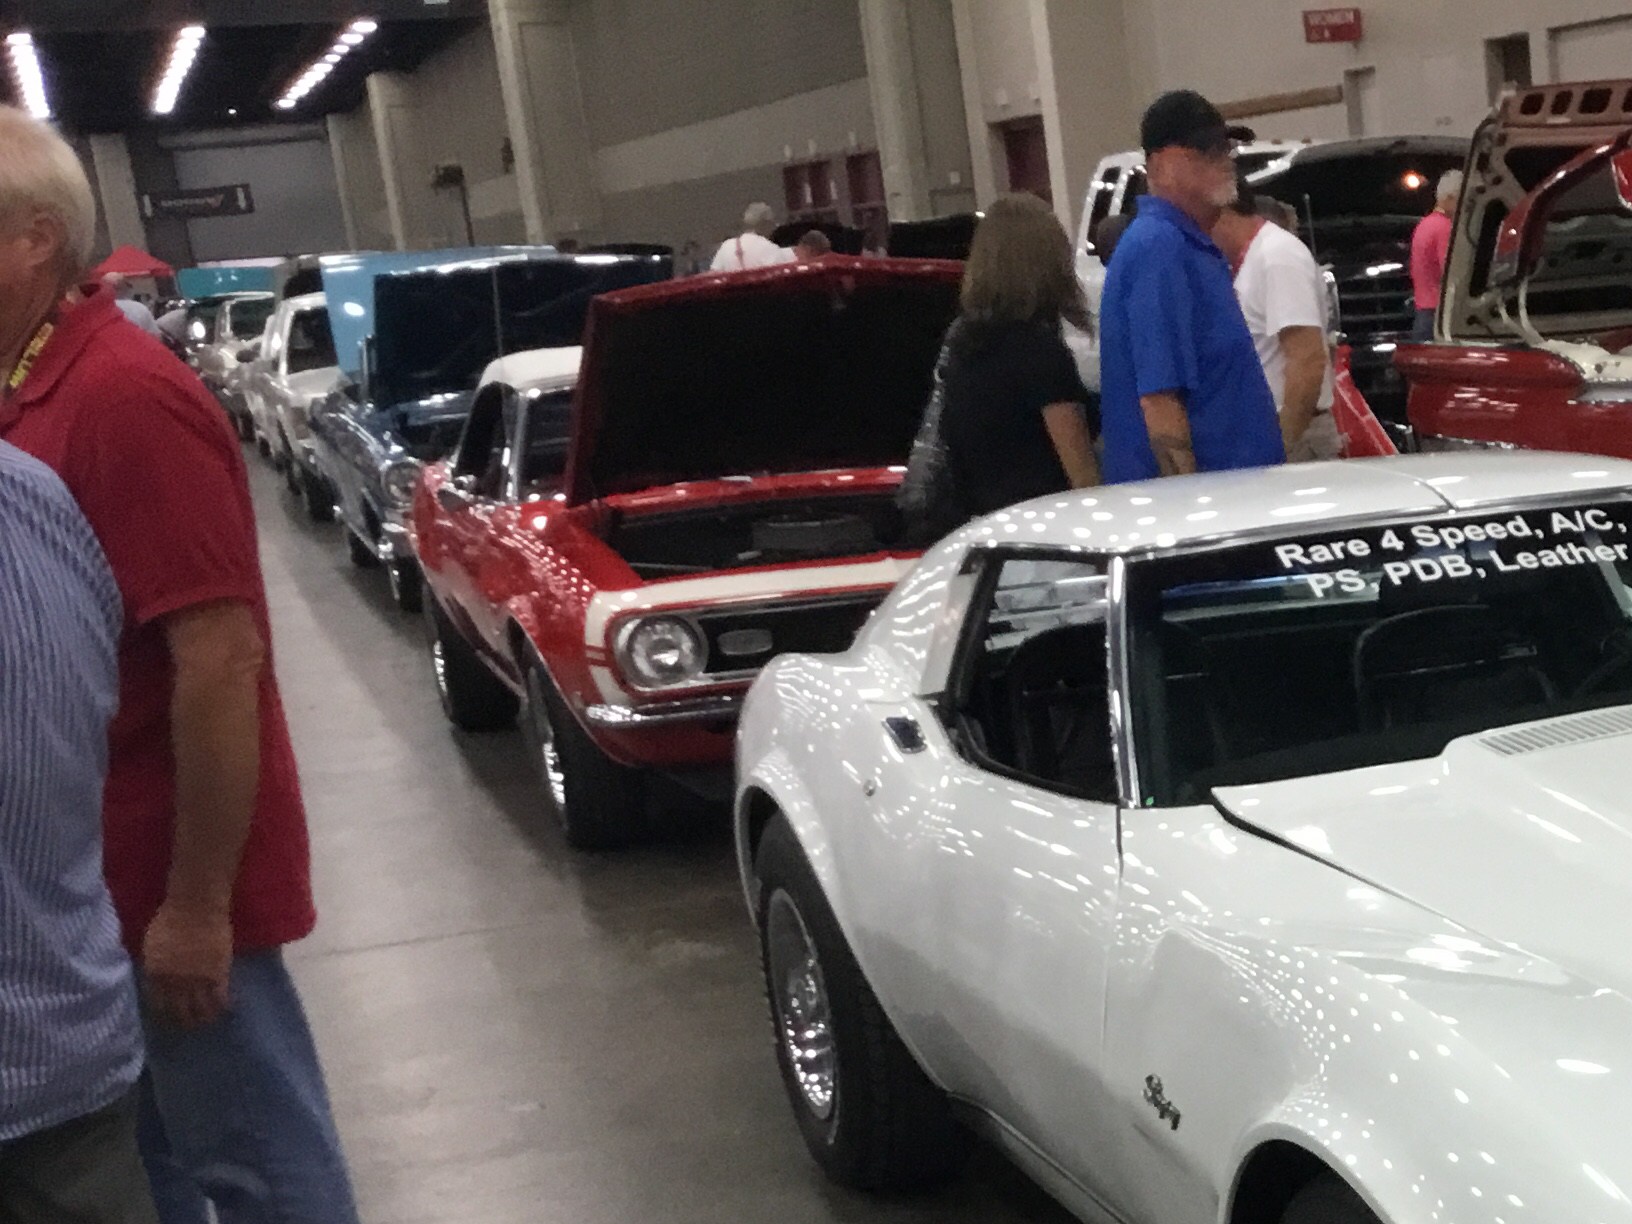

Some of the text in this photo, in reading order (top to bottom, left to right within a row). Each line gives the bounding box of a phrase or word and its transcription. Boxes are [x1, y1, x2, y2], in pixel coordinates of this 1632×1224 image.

[1274, 509, 1628, 569] Rare 4 Speed, A/C,
[1307, 542, 1629, 599] PS, PDB, Leather
